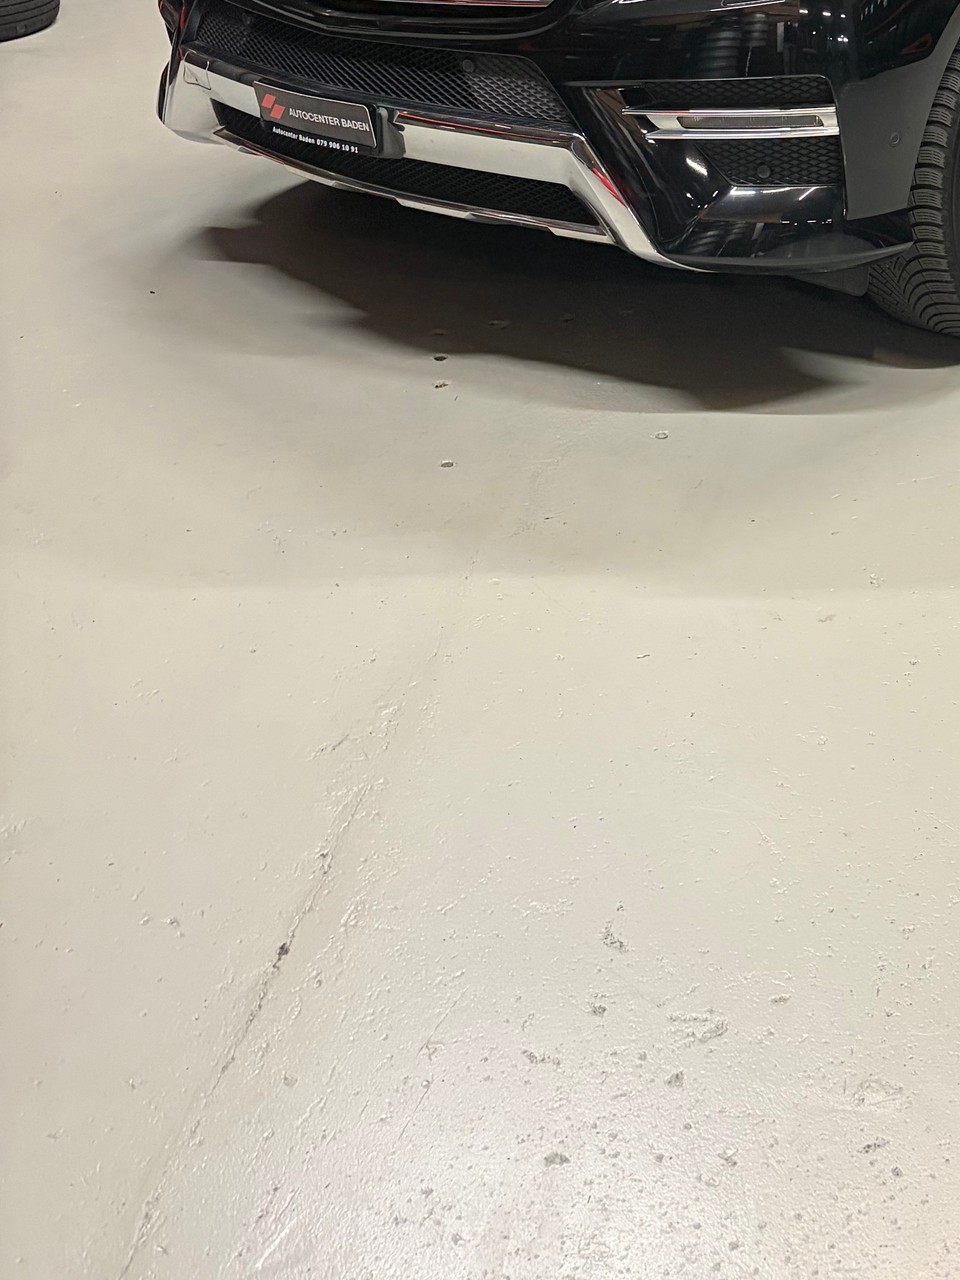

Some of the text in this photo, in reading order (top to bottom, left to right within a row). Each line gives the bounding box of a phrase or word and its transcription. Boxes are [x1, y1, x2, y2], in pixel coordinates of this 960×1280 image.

[289, 108, 369, 131] AUTOCENTER BADEN
[272, 126, 298, 139] Autocenter
[298, 134, 316, 144] Baden
[316, 138, 328, 147] 079
[341, 144, 350, 152] 10
[350, 145, 359, 153] 91
